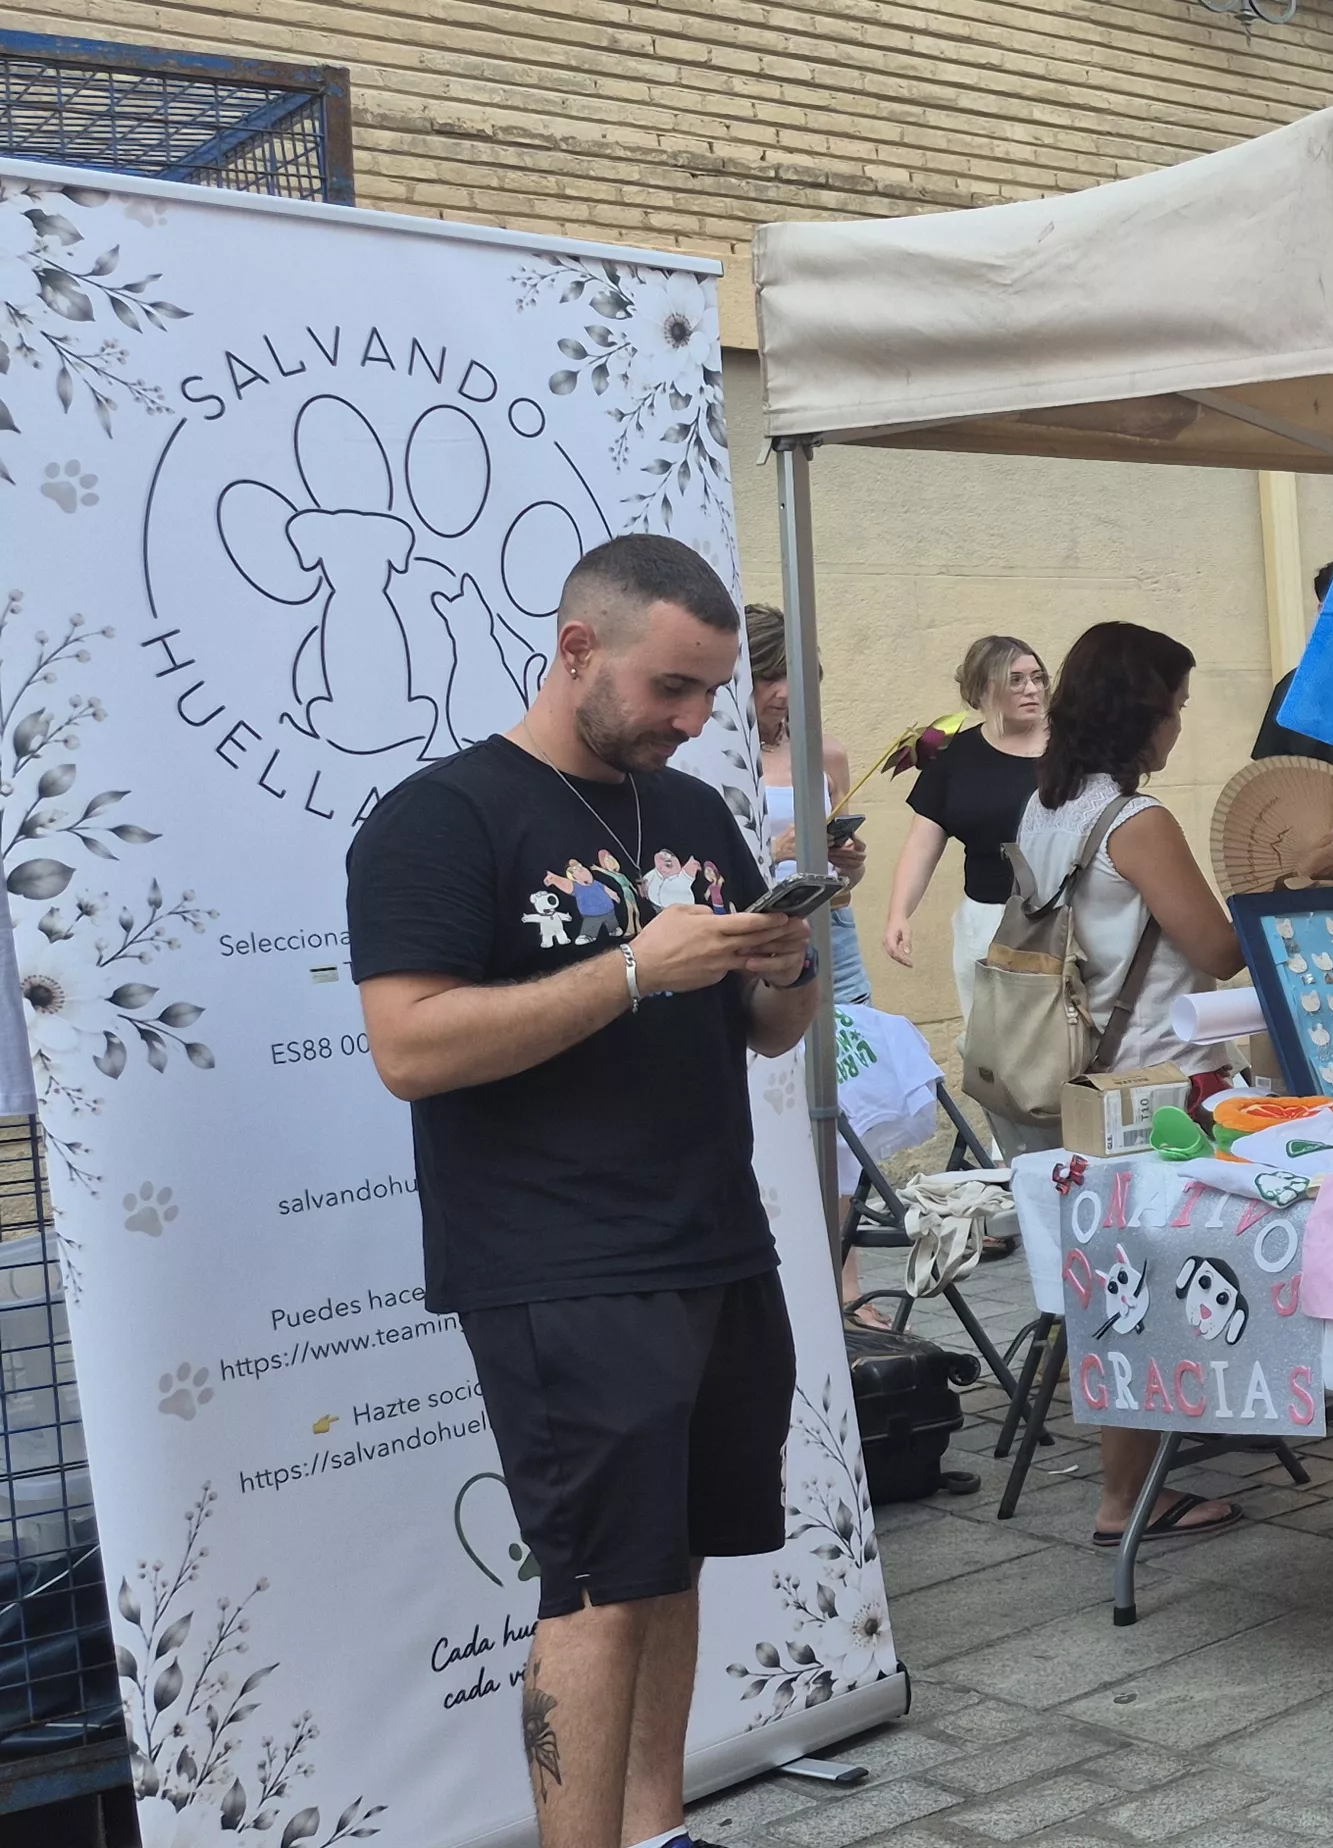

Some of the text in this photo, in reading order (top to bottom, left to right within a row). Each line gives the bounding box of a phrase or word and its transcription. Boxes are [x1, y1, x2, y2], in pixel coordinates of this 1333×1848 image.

[181, 325, 546, 438] SALVANDO
[270, 1037, 333, 1065] ES88
[1140, 1098, 1149, 1121] T10
[271, 1286, 426, 1331] Puedes hace
[219, 1312, 464, 1382] https://www.teamin
[352, 1397, 421, 1426] Hazte
[1079, 1351, 1315, 1426] GRACIAS
[239, 1410, 492, 1494] https://salvandohuel
[431, 1623, 496, 1673] Cada
[443, 1665, 501, 1710] cada
